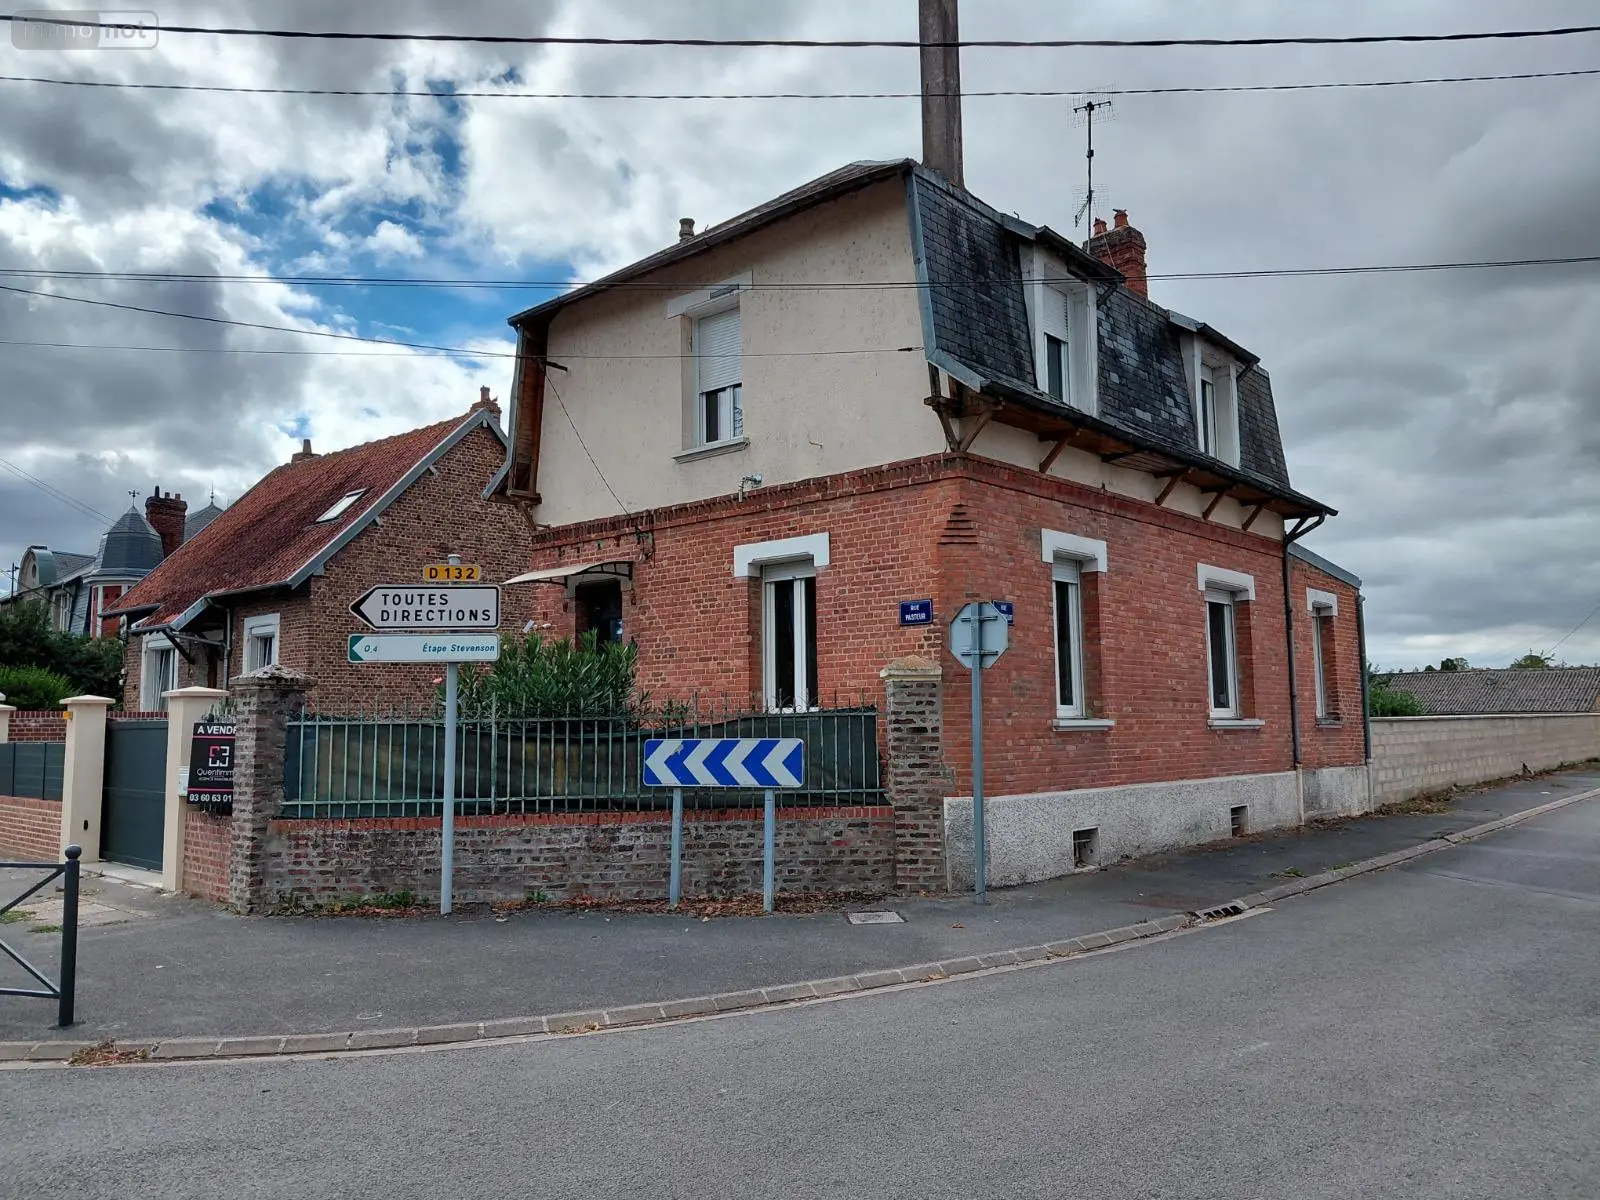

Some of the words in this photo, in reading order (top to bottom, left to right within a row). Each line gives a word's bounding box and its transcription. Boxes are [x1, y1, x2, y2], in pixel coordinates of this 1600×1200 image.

[429, 567, 438, 579] D
[444, 567, 475, 579] 132
[381, 593, 449, 606] TOUTES
[380, 609, 491, 622] DIRECTIONS
[905, 613, 926, 621] PASTEUR
[422, 643, 447, 654] Étape
[450, 644, 495, 653] Stevenson
[197, 726, 205, 734] A
